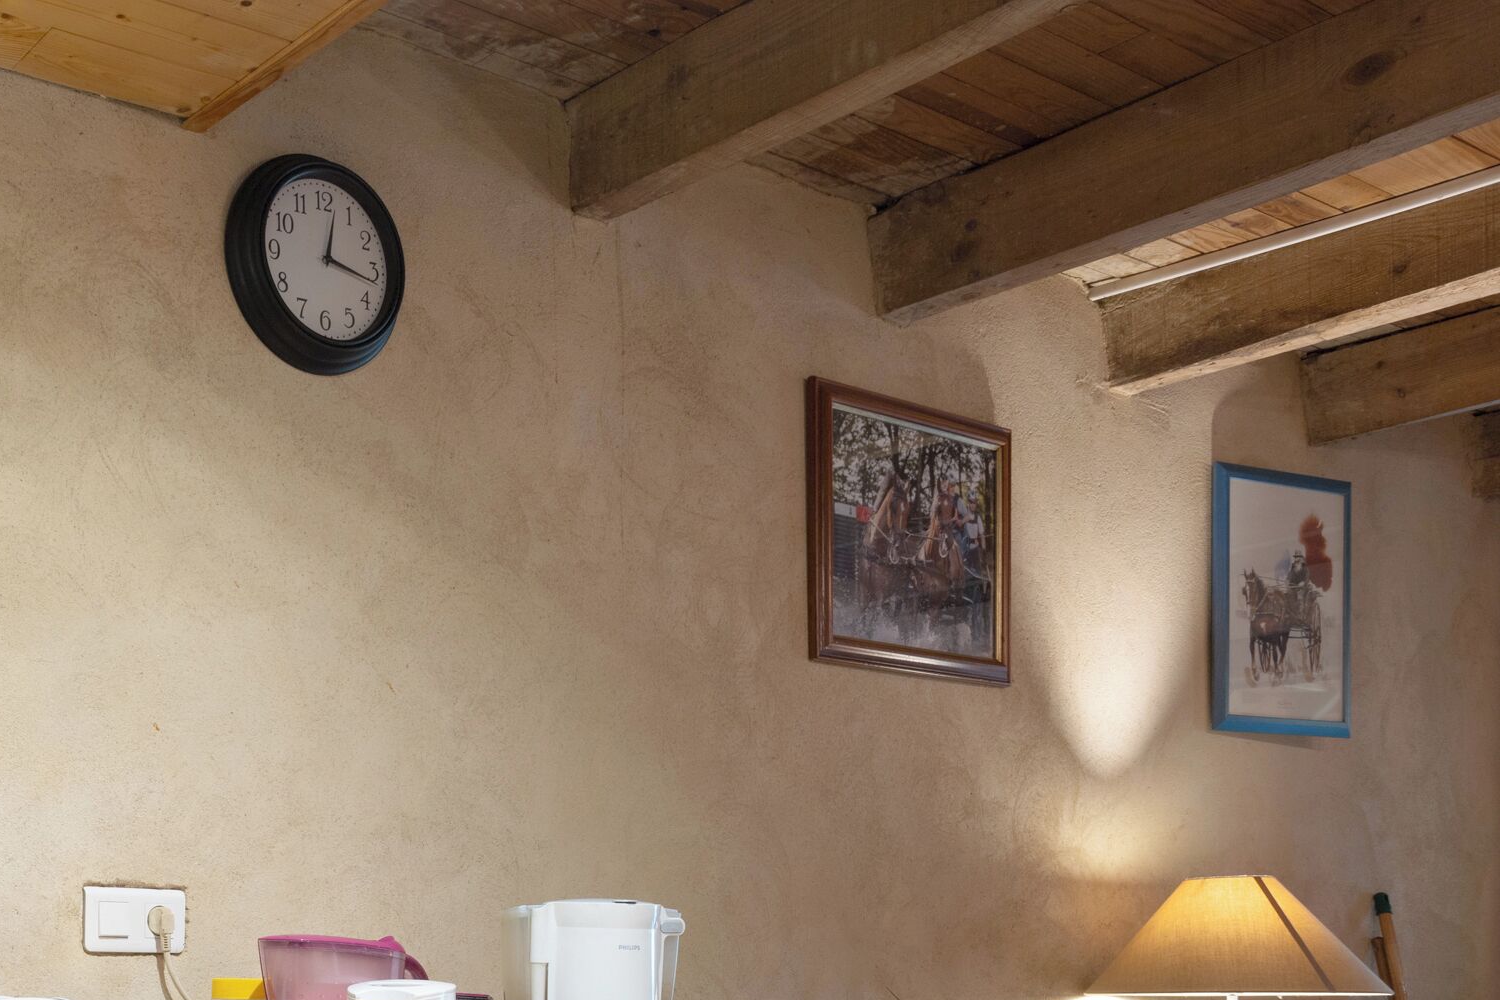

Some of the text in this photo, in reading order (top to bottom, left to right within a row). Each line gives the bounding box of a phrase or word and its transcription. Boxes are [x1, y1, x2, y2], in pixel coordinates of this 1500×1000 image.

[293, 193, 307, 214] 11
[315, 190, 333, 213] 12
[275, 211, 294, 234] 10
[346, 207, 352, 226] 1
[268, 238, 281, 260] 9
[360, 230, 371, 251] 2
[277, 271, 289, 293] 8
[369, 261, 379, 283] 3
[296, 297, 307, 319] 7
[360, 291, 371, 310] 4
[319, 310, 331, 331] 6
[343, 307, 355, 328] 5
